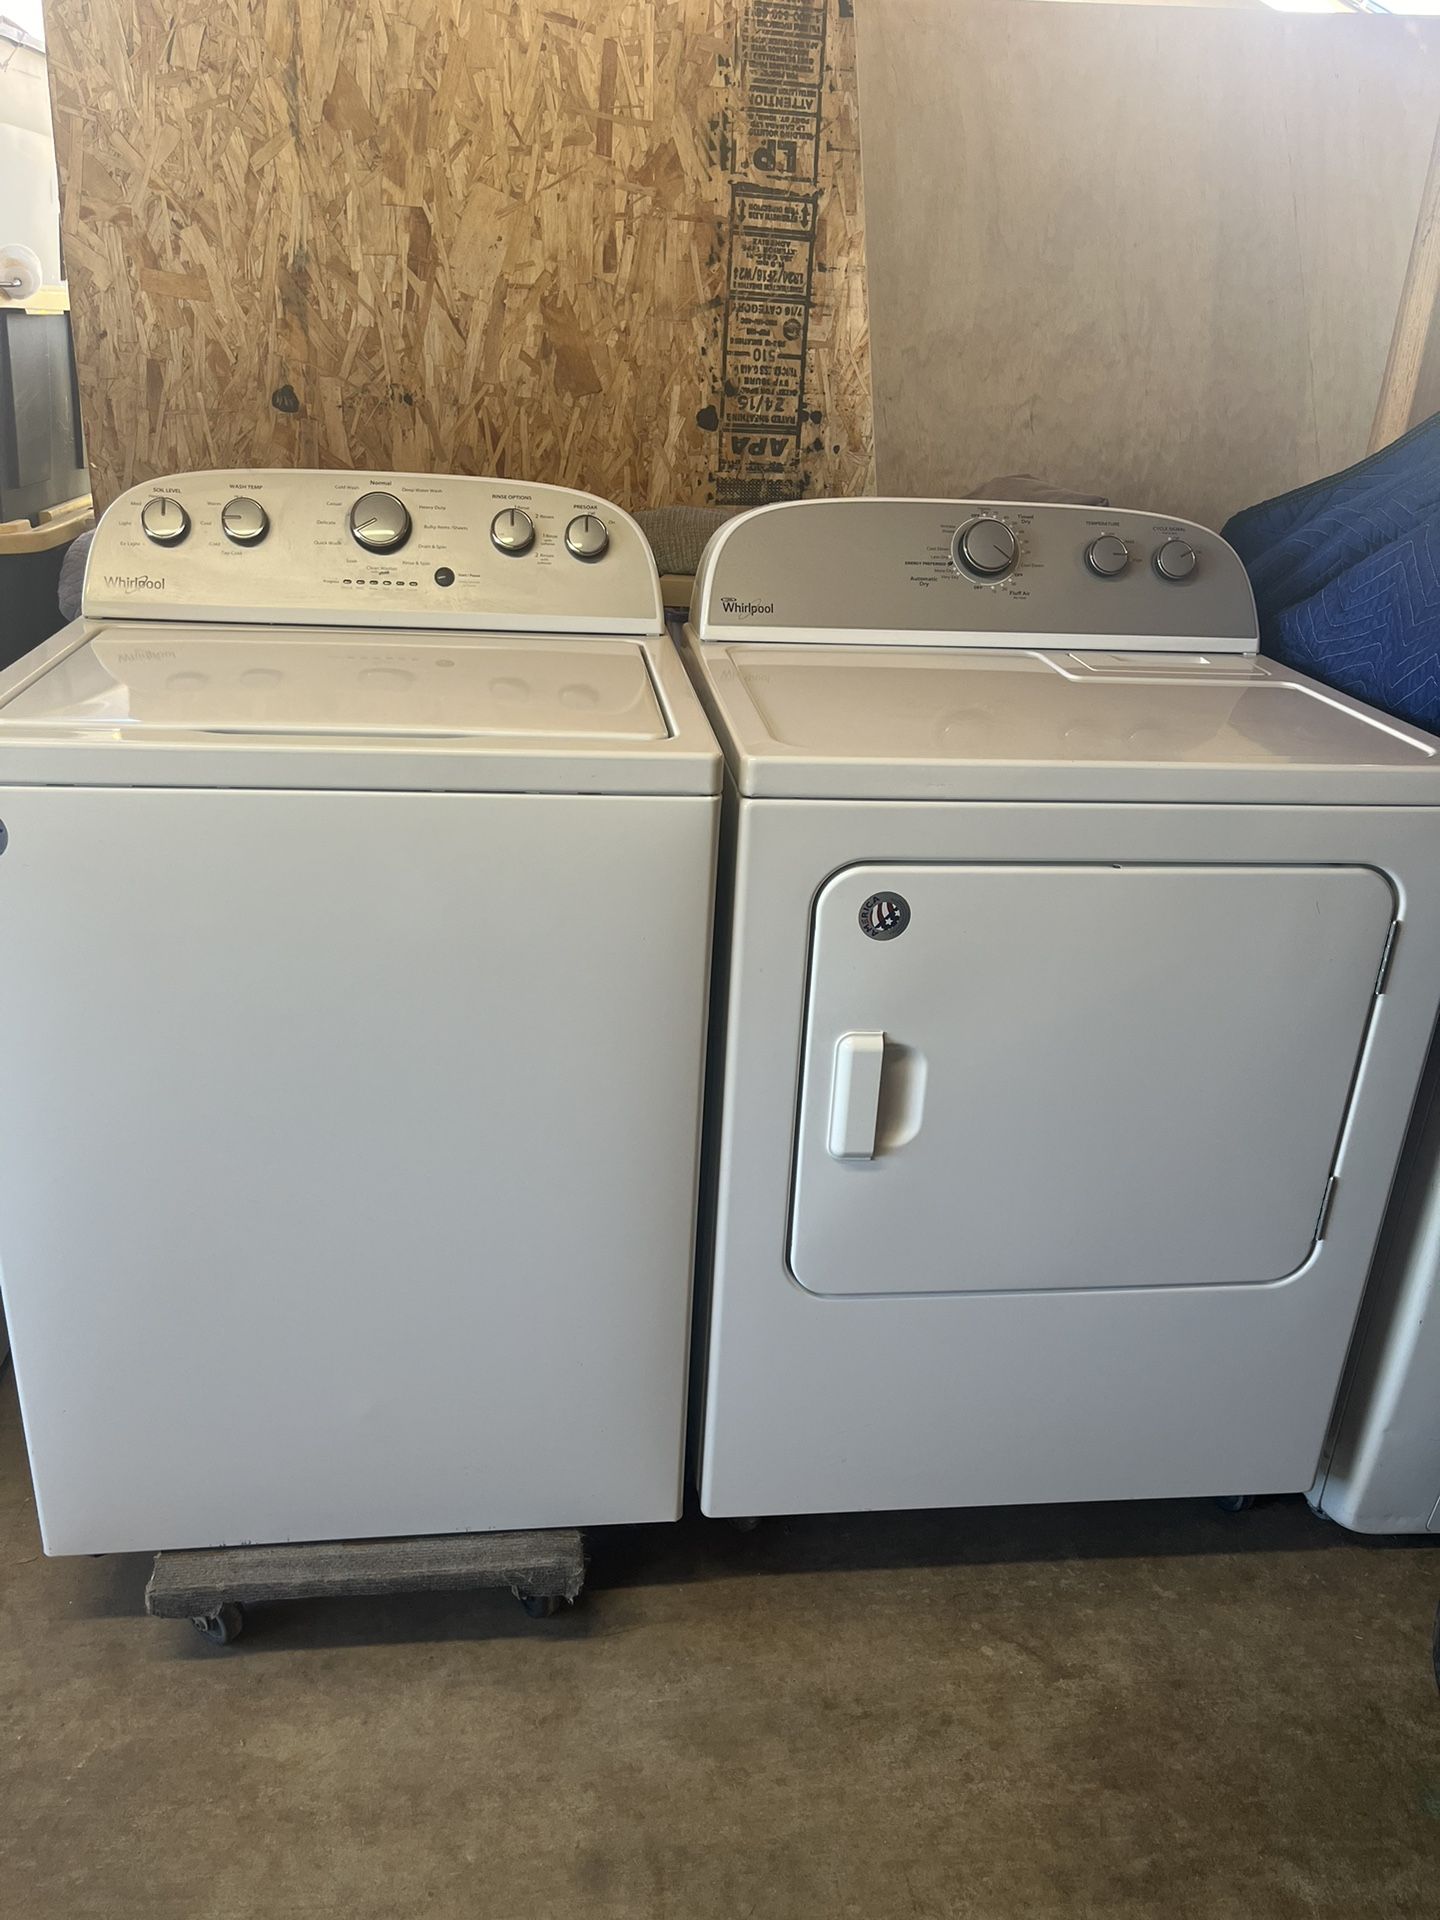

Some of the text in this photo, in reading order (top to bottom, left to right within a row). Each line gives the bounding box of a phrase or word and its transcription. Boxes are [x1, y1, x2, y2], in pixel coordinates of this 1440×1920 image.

[753, 140, 797, 173] LP
[784, 306, 802, 317] 7/16
[752, 348, 776, 362] 510
[736, 395, 784, 413] 24/16
[772, 415, 796, 424] RATED
[731, 436, 790, 457] APA
[104, 576, 166, 592] Whirlpool
[722, 602, 774, 616] Whirlpool
[861, 896, 880, 936] AMERICA
